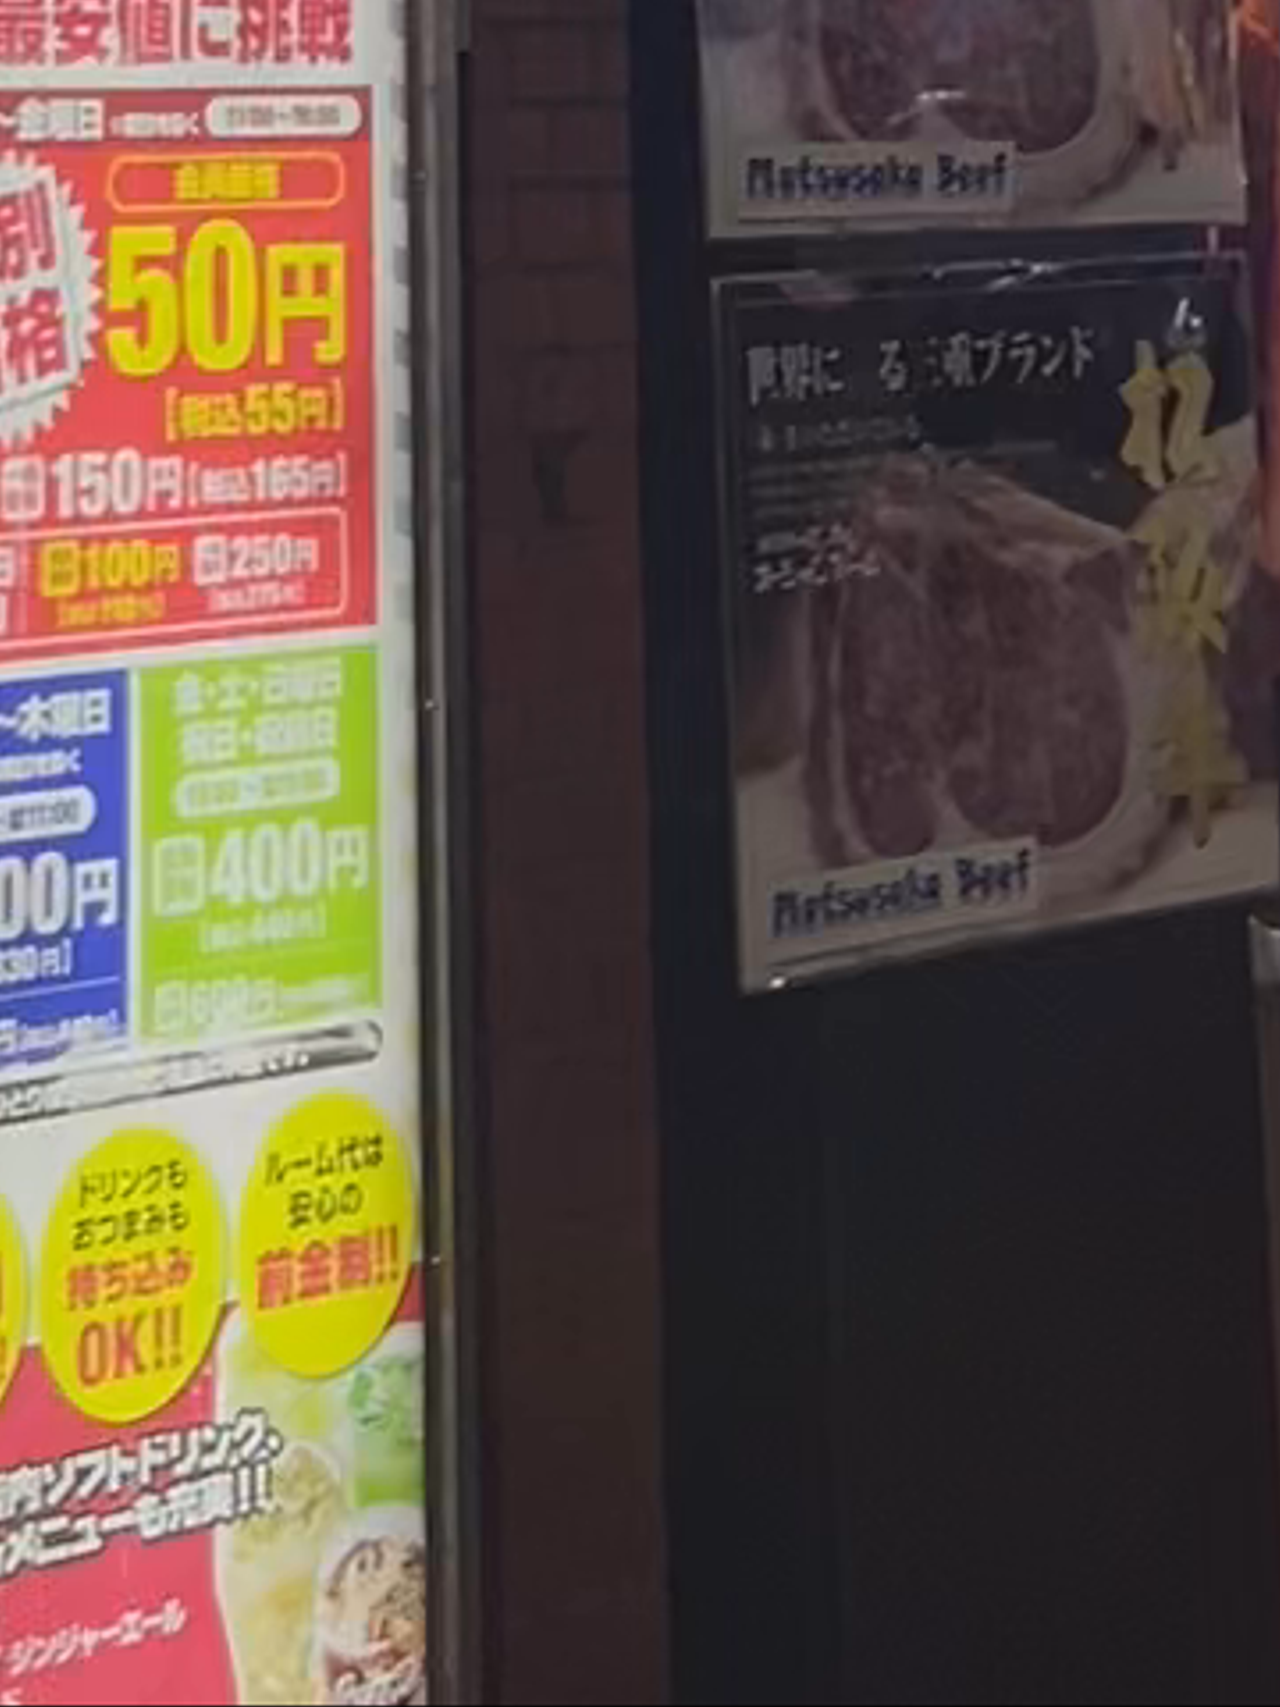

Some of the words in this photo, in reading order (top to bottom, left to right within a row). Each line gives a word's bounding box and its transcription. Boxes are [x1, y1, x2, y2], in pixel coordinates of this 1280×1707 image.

[105, 218, 347, 377] 50円
[77, 1158, 188, 1209] ドリンクも
[264, 1132, 385, 1186] ルーム代は
[72, 1198, 192, 1252] おつまみも
[288, 1182, 365, 1231] 安心の
[65, 1247, 195, 1313] 持ち込み
